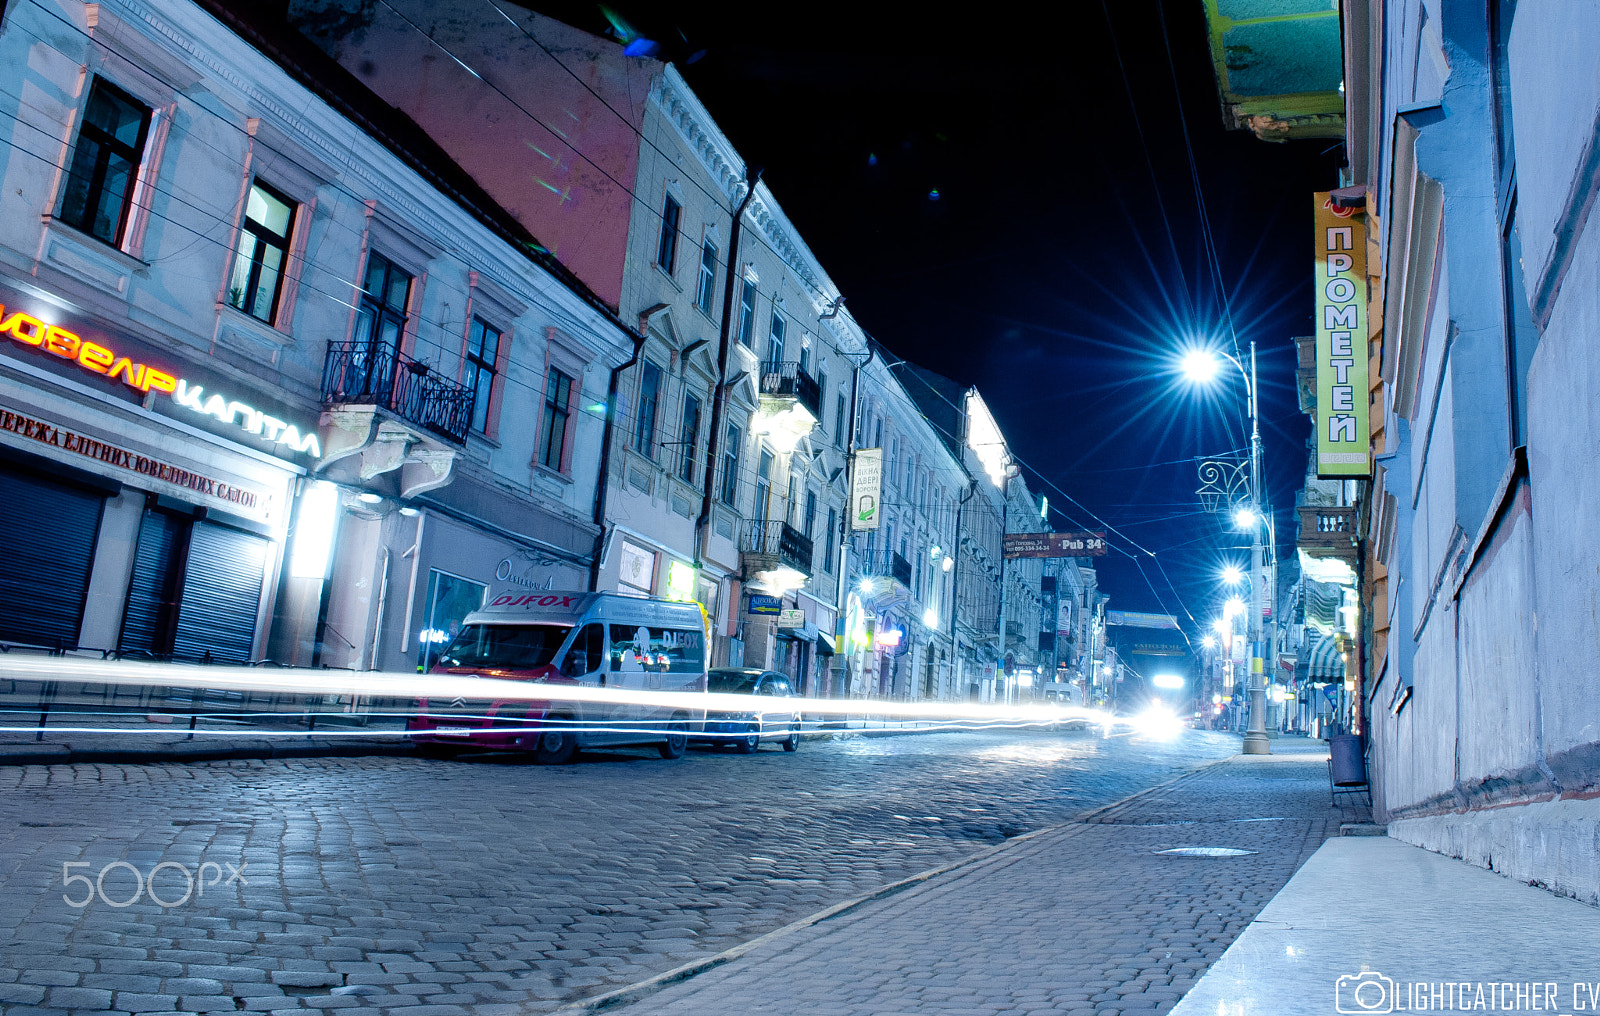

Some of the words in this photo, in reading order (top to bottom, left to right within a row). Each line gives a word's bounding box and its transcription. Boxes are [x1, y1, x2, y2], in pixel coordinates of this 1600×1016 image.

[1324, 226, 1358, 443] ПРОМЕТЕЙ
[63, 431, 133, 470] ЕЛІТНИХ
[134, 454, 216, 496] ЮВЕЛІРНИХ
[857, 467, 879, 476] ВІКНА
[856, 475, 879, 486] ДВЕРІ
[1062, 540, 1084, 550] Pub
[1087, 539, 1102, 549] 34
